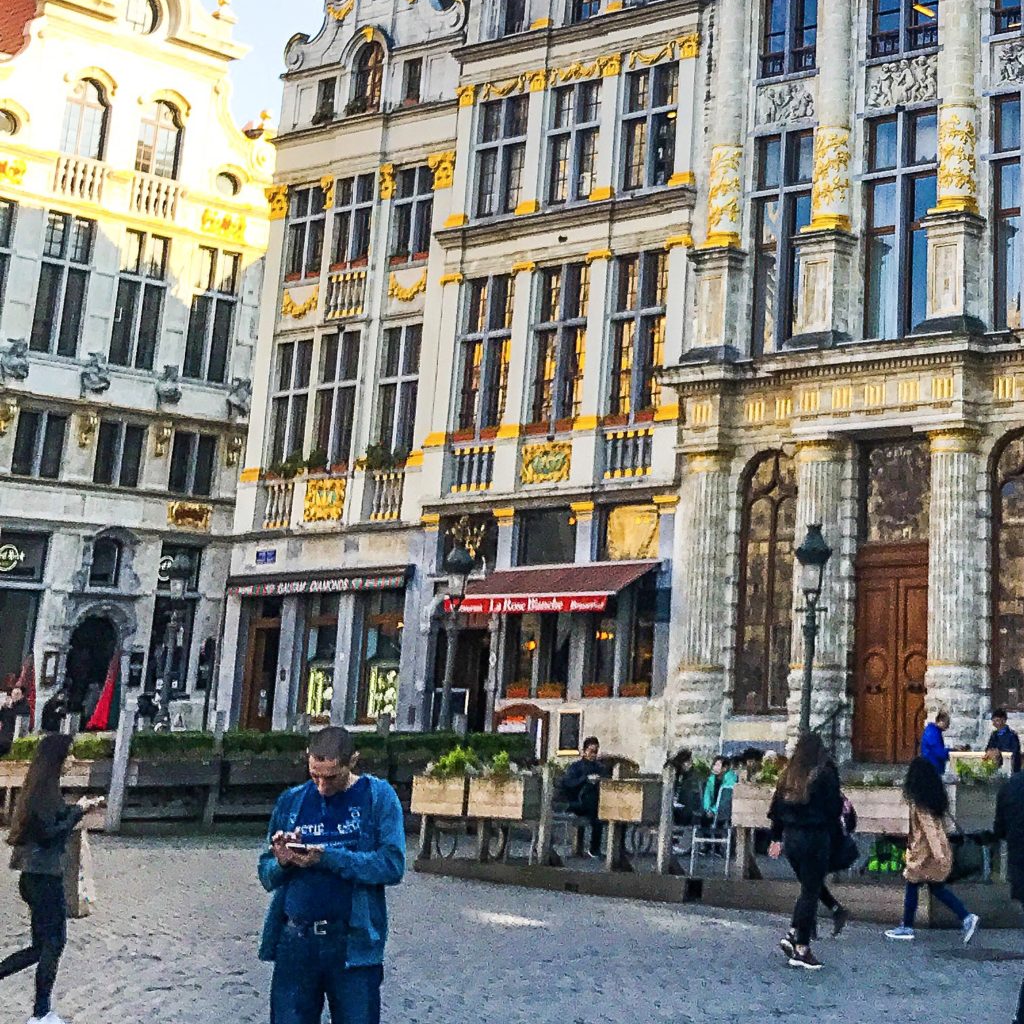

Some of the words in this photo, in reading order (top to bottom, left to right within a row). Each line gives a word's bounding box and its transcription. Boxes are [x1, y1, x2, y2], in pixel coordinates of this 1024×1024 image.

[489, 597, 502, 612] La
[503, 597, 527, 612] Rose
[528, 596, 564, 611] Blanche
